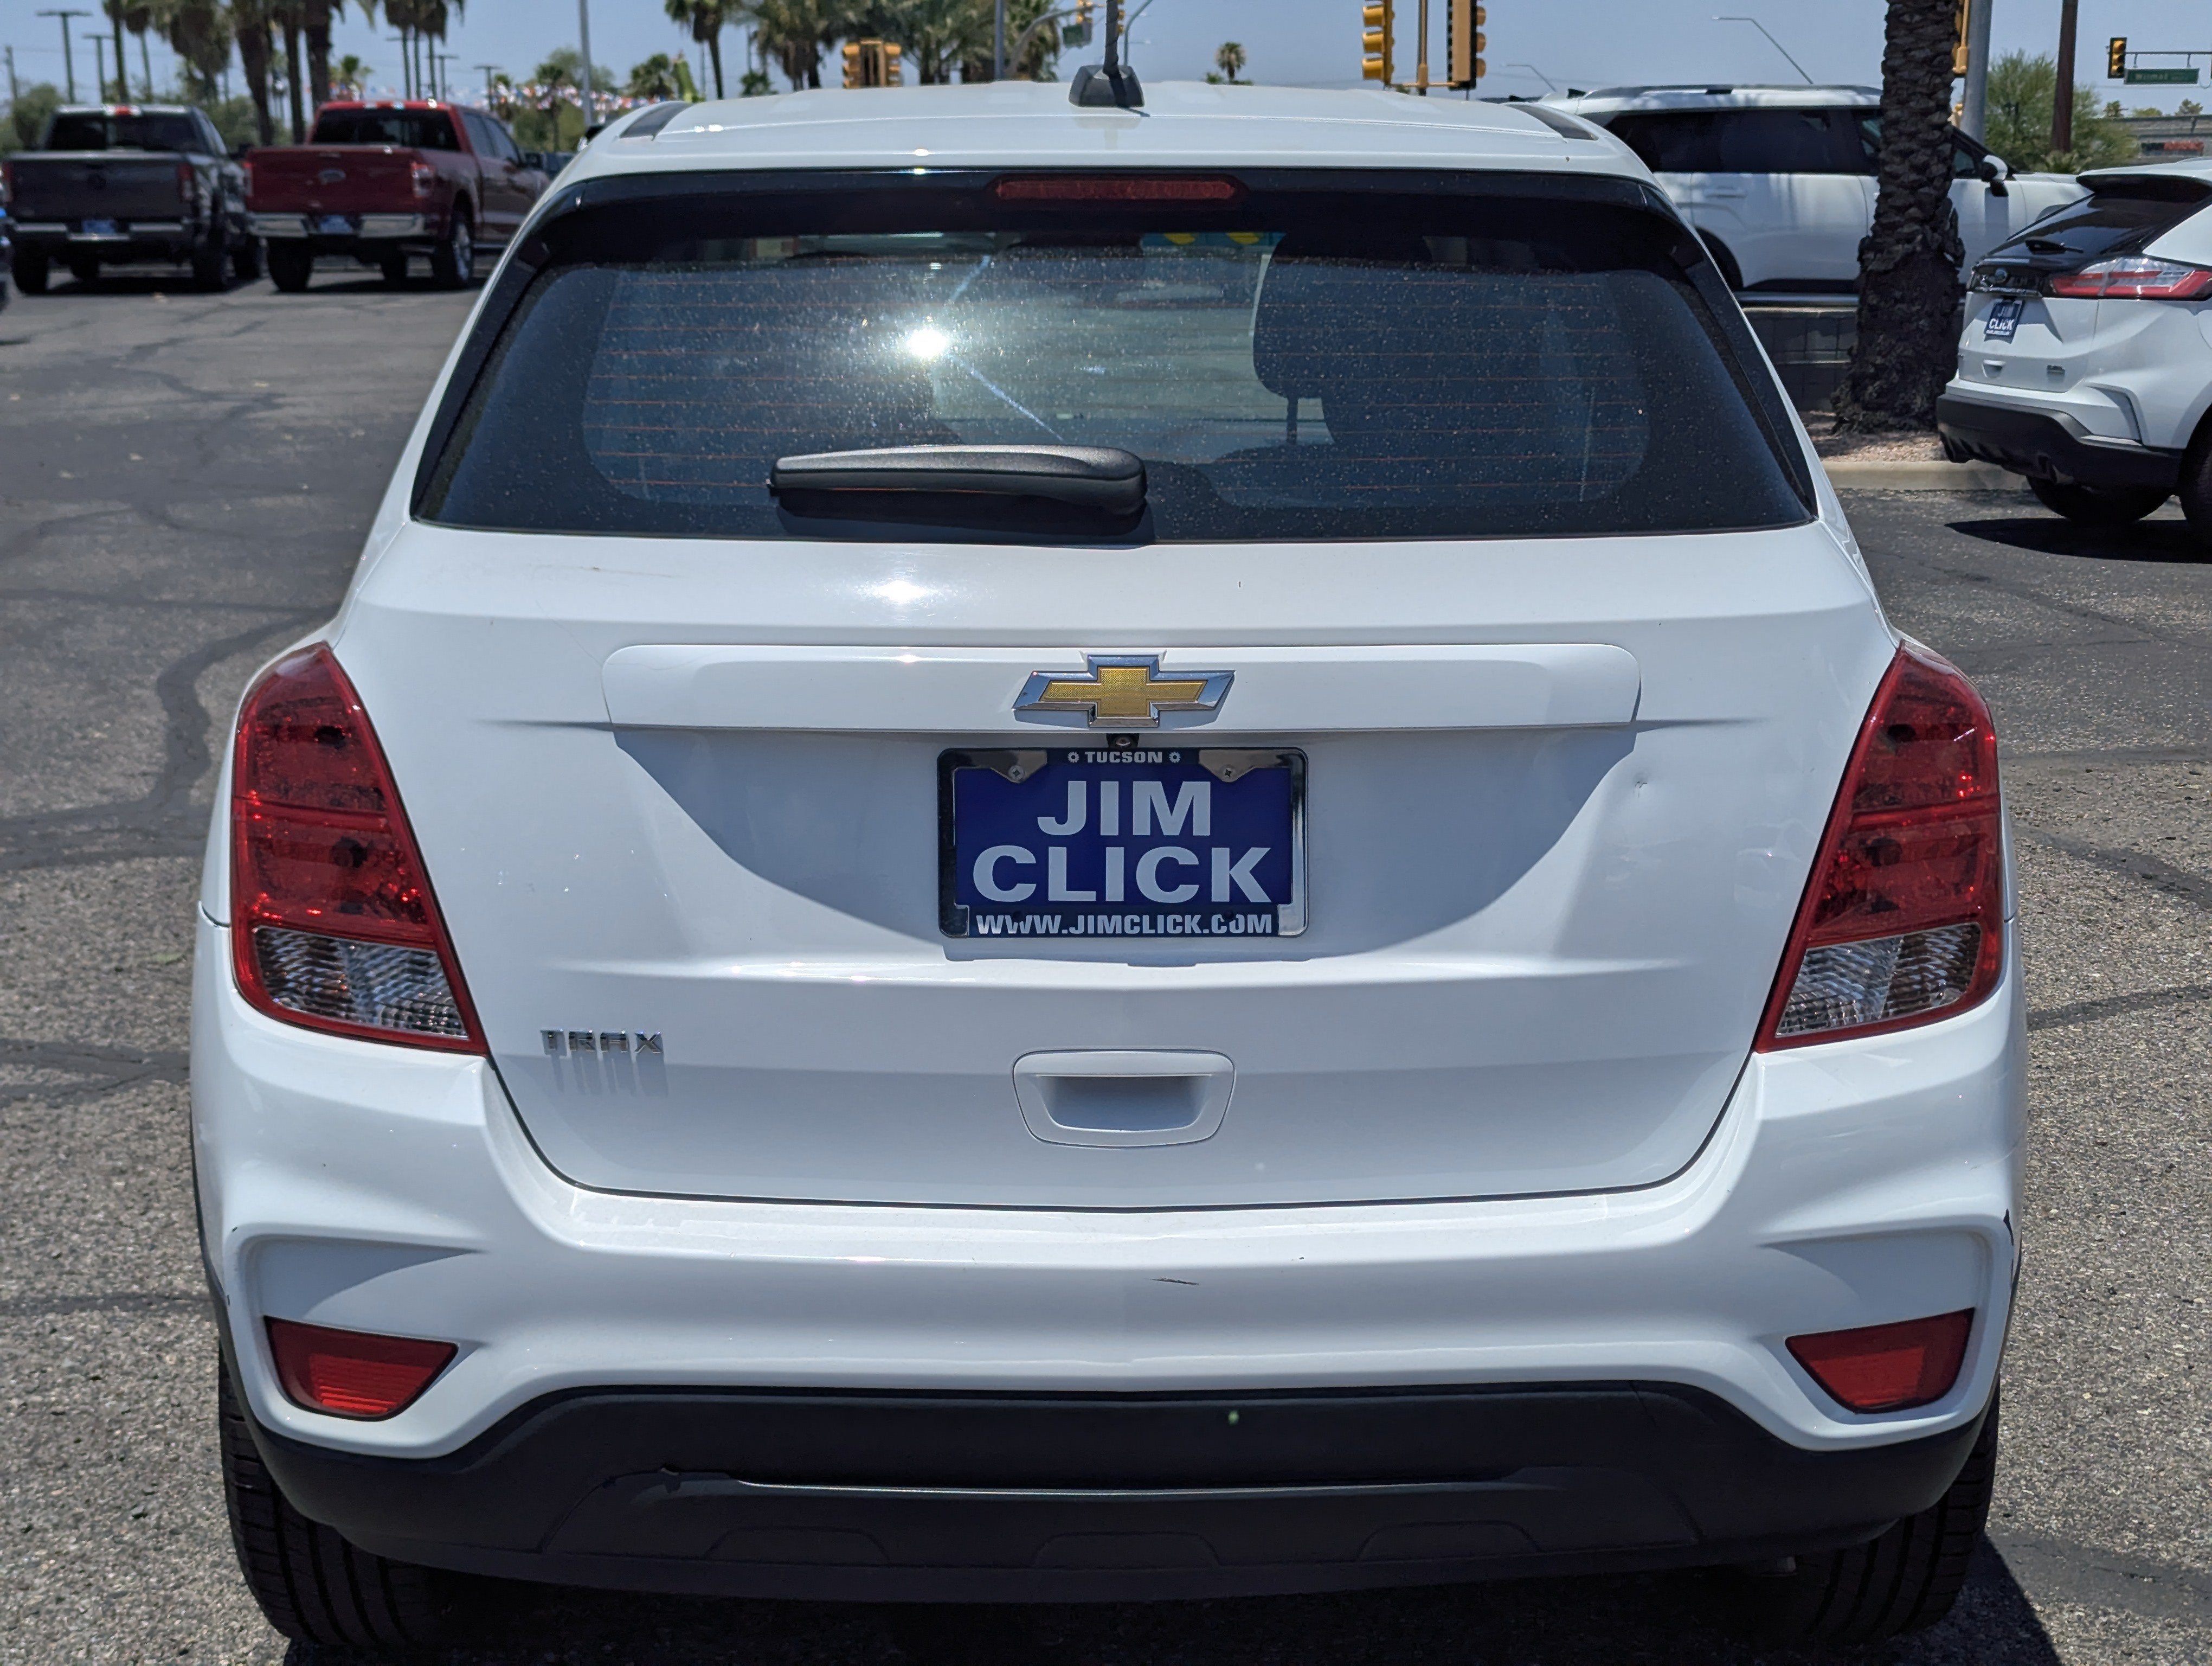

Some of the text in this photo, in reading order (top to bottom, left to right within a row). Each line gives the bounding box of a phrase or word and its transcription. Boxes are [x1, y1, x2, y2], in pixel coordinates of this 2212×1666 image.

[1989, 318, 2015, 330] CLICK
[1084, 751, 1162, 763] TUCSON
[1037, 780, 1211, 836] JIM
[973, 845, 1272, 904] CLICK
[976, 913, 1272, 934] WWW.JIMCLICK.COM
[540, 1029, 661, 1054] TRAX
